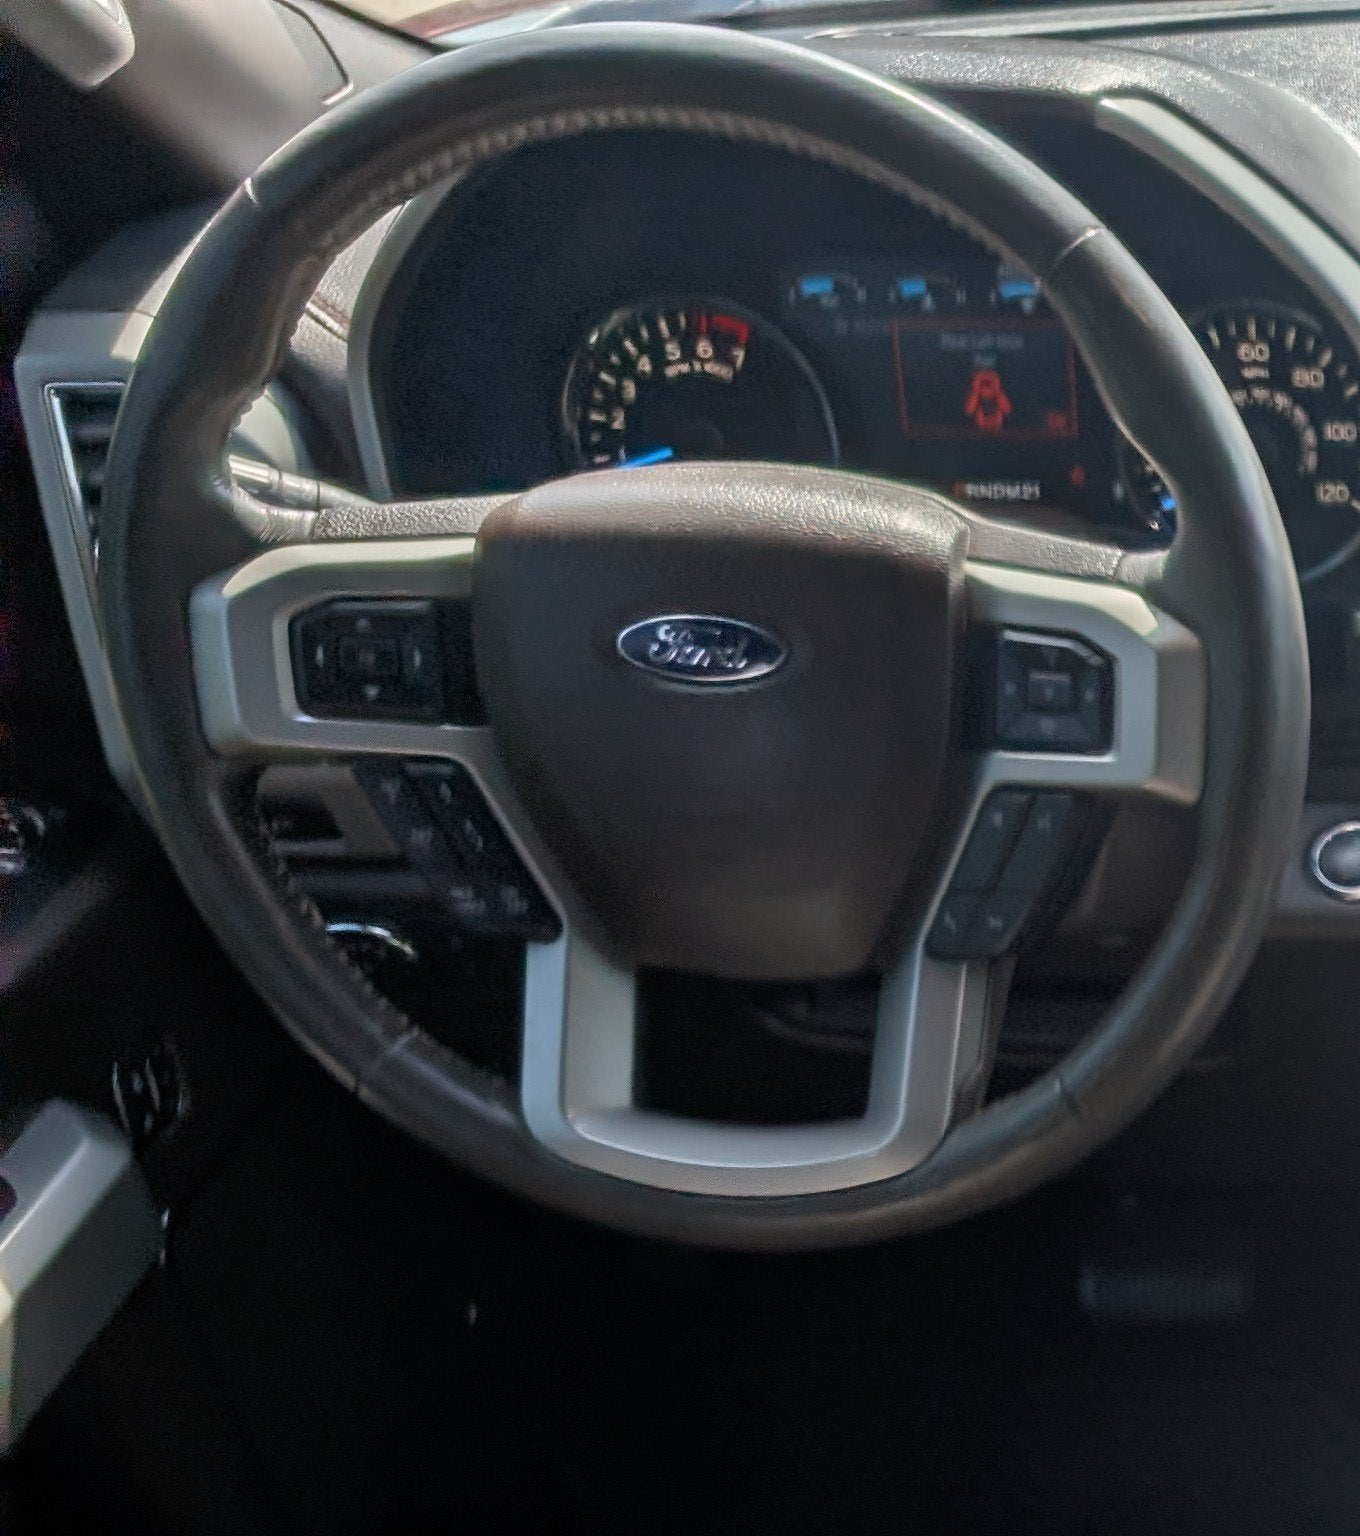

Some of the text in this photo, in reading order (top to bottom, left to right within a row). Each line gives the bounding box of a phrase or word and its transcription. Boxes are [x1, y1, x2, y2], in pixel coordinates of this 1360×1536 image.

[664, 340, 681, 361] 5
[696, 337, 713, 359] 6
[732, 346, 746, 371] 7
[1237, 342, 1271, 363] 60
[637, 353, 653, 374] 4
[1291, 367, 1325, 389] 80
[610, 407, 626, 431] 2
[1323, 422, 1358, 442] 100
[1314, 481, 1350, 503] 120
